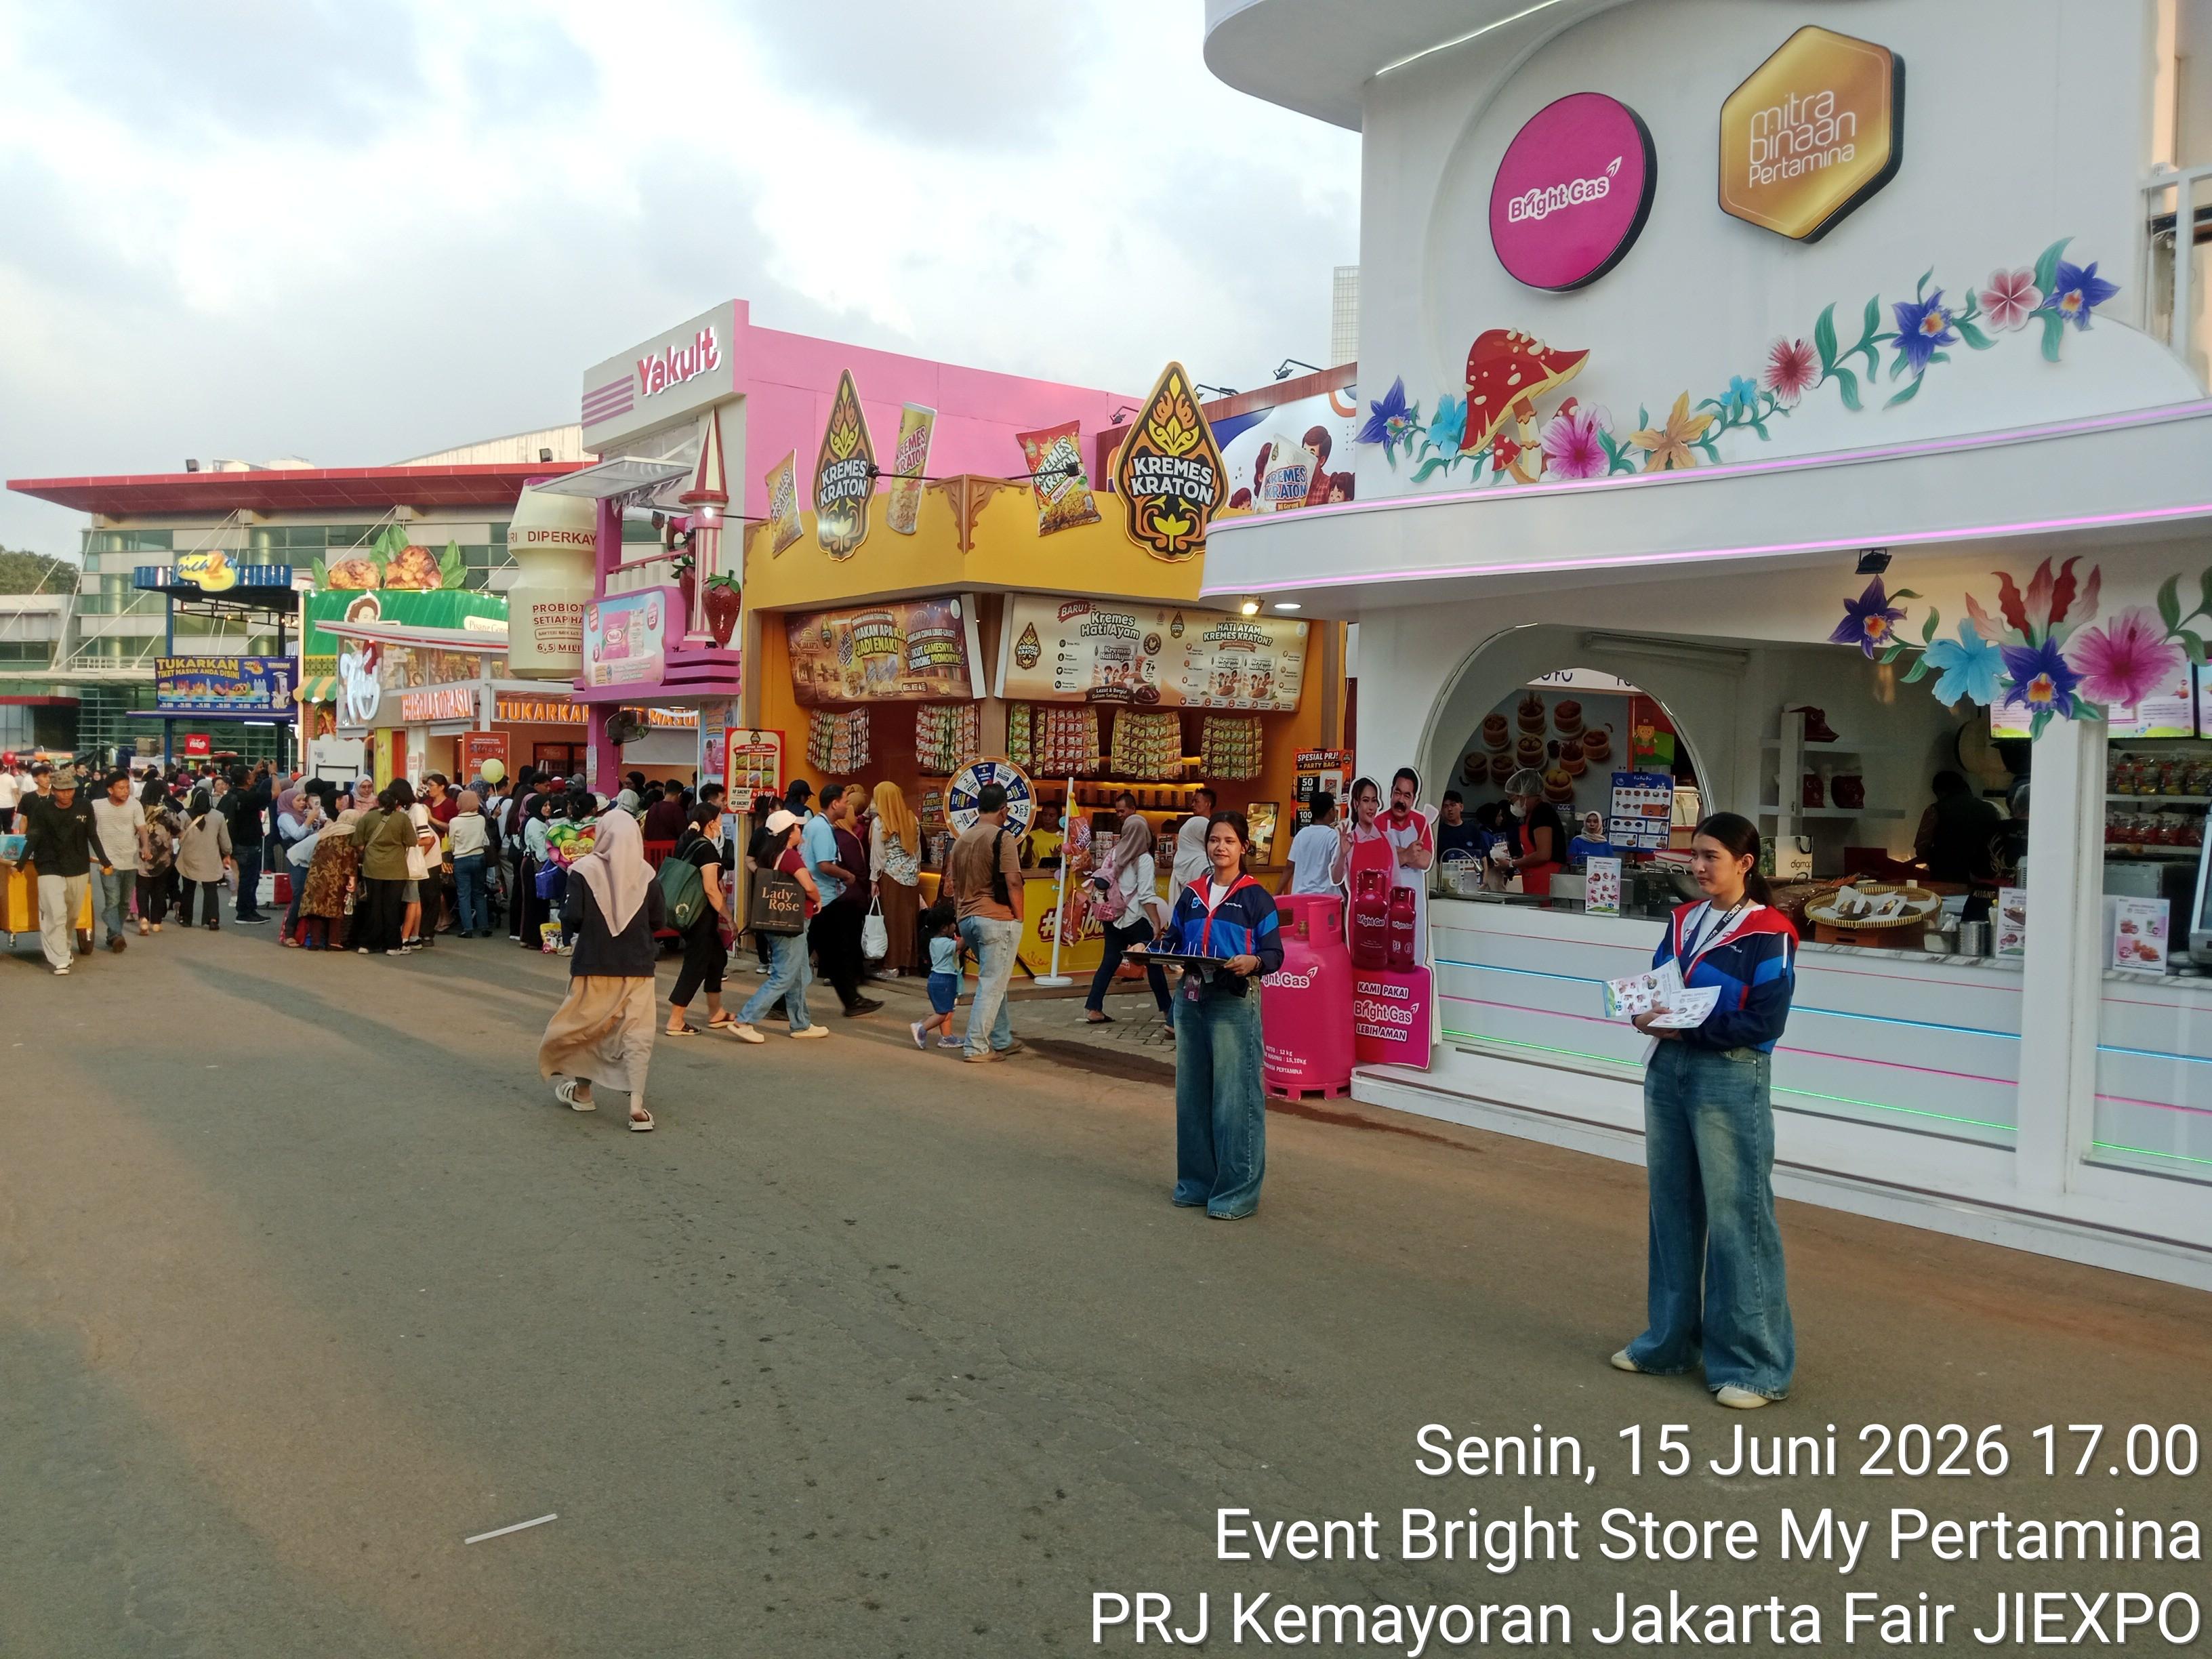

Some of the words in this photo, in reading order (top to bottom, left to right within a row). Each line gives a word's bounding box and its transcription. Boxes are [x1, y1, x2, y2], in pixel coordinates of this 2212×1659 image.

[1750, 90, 1834, 135] mitra
[1750, 111, 1856, 165] binaan
[1749, 143, 1855, 188] Pertamina
[1509, 188, 1568, 222] Bright
[1568, 178, 1610, 205] Gas
[637, 327, 722, 396] Yakult
[821, 460, 868, 487] KREMES
[1133, 457, 1212, 485] KREMES
[1266, 468, 1306, 484] KREMES
[819, 478, 868, 508] KRATON
[1130, 476, 1214, 506] KRATON
[1266, 484, 1307, 499] KRATON
[533, 603, 584, 613] PROBIOT
[1061, 605, 1088, 617] BARU!
[534, 616, 568, 625] SETIAP
[1091, 611, 1135, 626] Kremes
[855, 624, 879, 641] MAKAN
[880, 624, 893, 638] APA
[1081, 623, 1108, 637] Hati
[1108, 625, 1140, 640] Ayam
[1217, 623, 1236, 631] HATI
[1237, 623, 1262, 635] AYAM
[537, 643, 554, 652] 6,5
[856, 638, 874, 657] JADI
[874, 637, 898, 653] ENAK!
[1204, 631, 1237, 642] KREMES
[1237, 632, 1273, 647] KRATON?
[156, 658, 239, 671] TUKARKAN
[909, 655, 931, 670] BORONG
[157, 670, 175, 679] TIKET
[176, 668, 199, 676] MASUK
[200, 668, 220, 676] ANDA
[648, 708, 699, 727] MASU
[1297, 752, 1324, 762] SPESIAL
[1324, 752, 1339, 760] PRJ!
[1302, 777, 1313, 787] 50
[762, 887, 794, 903] Lady
[769, 899, 800, 913] Rose
[1722, 903, 1742, 923] RIDER
[1261, 971, 1280, 987] ght
[1280, 971, 1310, 989] Gas
[1357, 982, 1380, 996] KAMI
[1382, 986, 1409, 1000] PAKAI
[1354, 1000, 1389, 1022] Bright
[1389, 1007, 1412, 1025] Gas
[1356, 1023, 1379, 1037] LEBIH
[1379, 1027, 1408, 1042] AMAN
[1276, 1064, 1303, 1075] PERTAMINA
